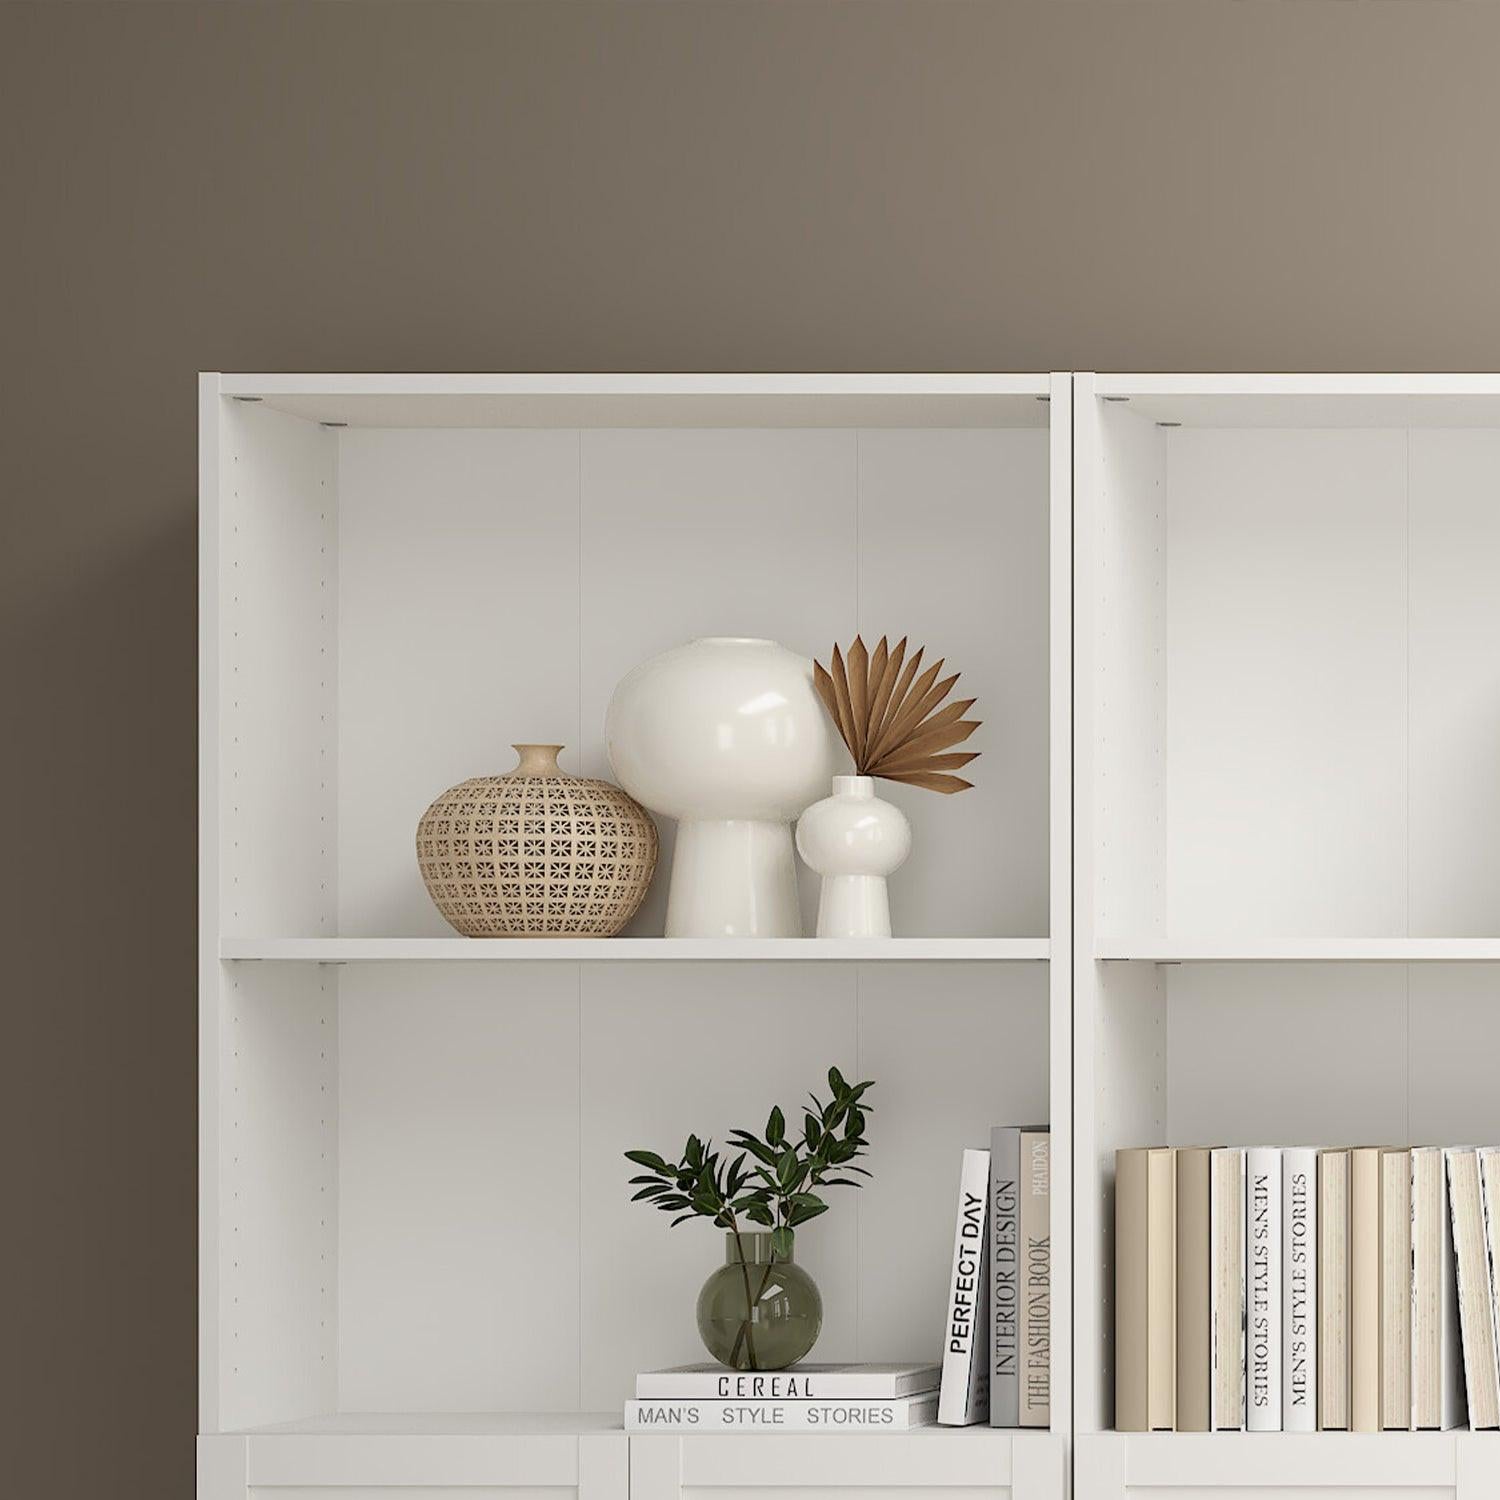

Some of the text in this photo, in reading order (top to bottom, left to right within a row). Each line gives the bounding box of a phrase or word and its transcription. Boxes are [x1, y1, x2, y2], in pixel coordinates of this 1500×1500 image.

[1032, 1140, 1048, 1196] PHAIDON
[950, 1192, 982, 1354] PERFECT DAY
[996, 1179, 1016, 1376] INTERIOR DESIGN
[1028, 1238, 1050, 1410] THE FASHION BOOK
[1254, 1174, 1269, 1407] MEN'S STYLE STORIES
[1292, 1173, 1307, 1406] MEN'S STYLE STORIES
[638, 1407, 894, 1424] MAN'S STYLE STORIES
[717, 1376, 814, 1397] CEREAL
